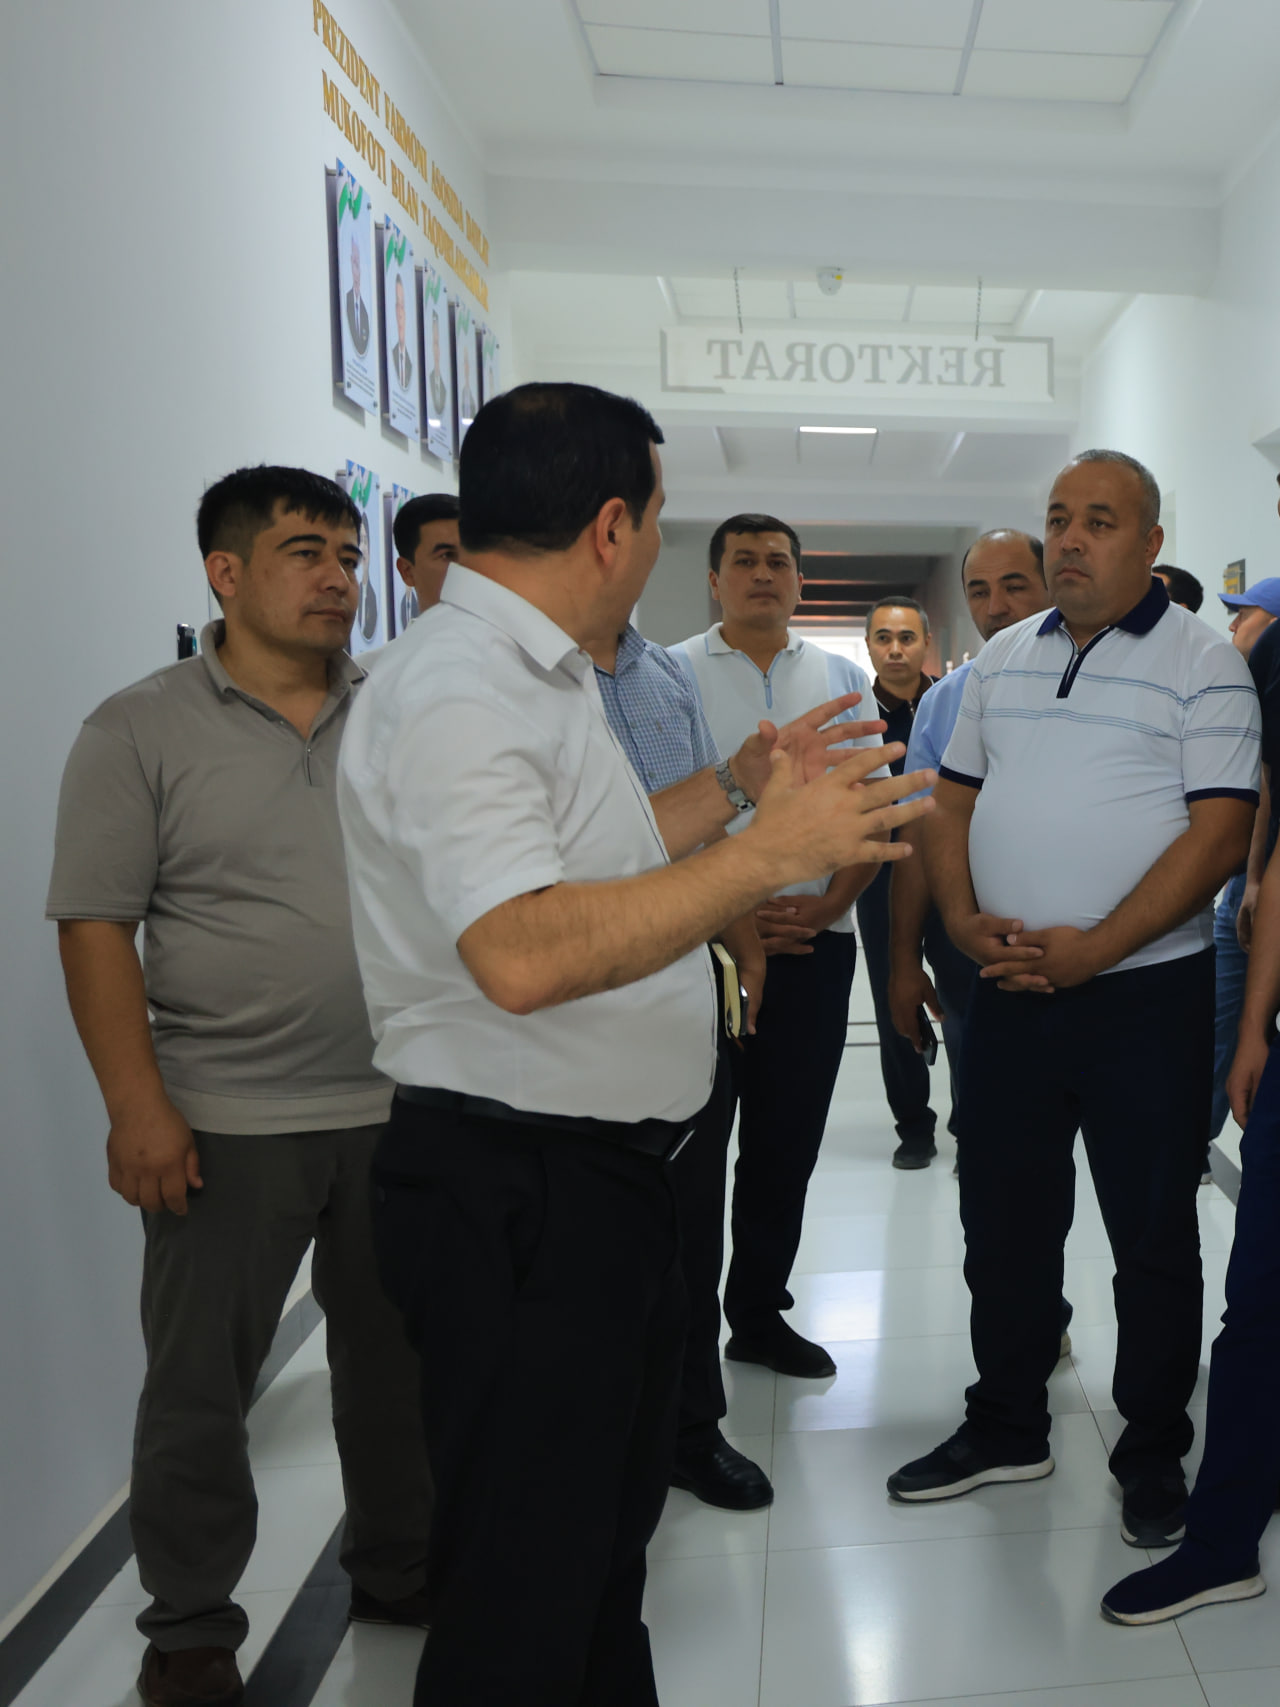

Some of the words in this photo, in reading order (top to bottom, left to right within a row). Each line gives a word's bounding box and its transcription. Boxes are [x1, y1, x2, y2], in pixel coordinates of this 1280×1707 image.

[312, 0, 380, 118] PREZIDENT
[322, 69, 387, 186] MUKOFOTI
[390, 159, 420, 226] BILAN
